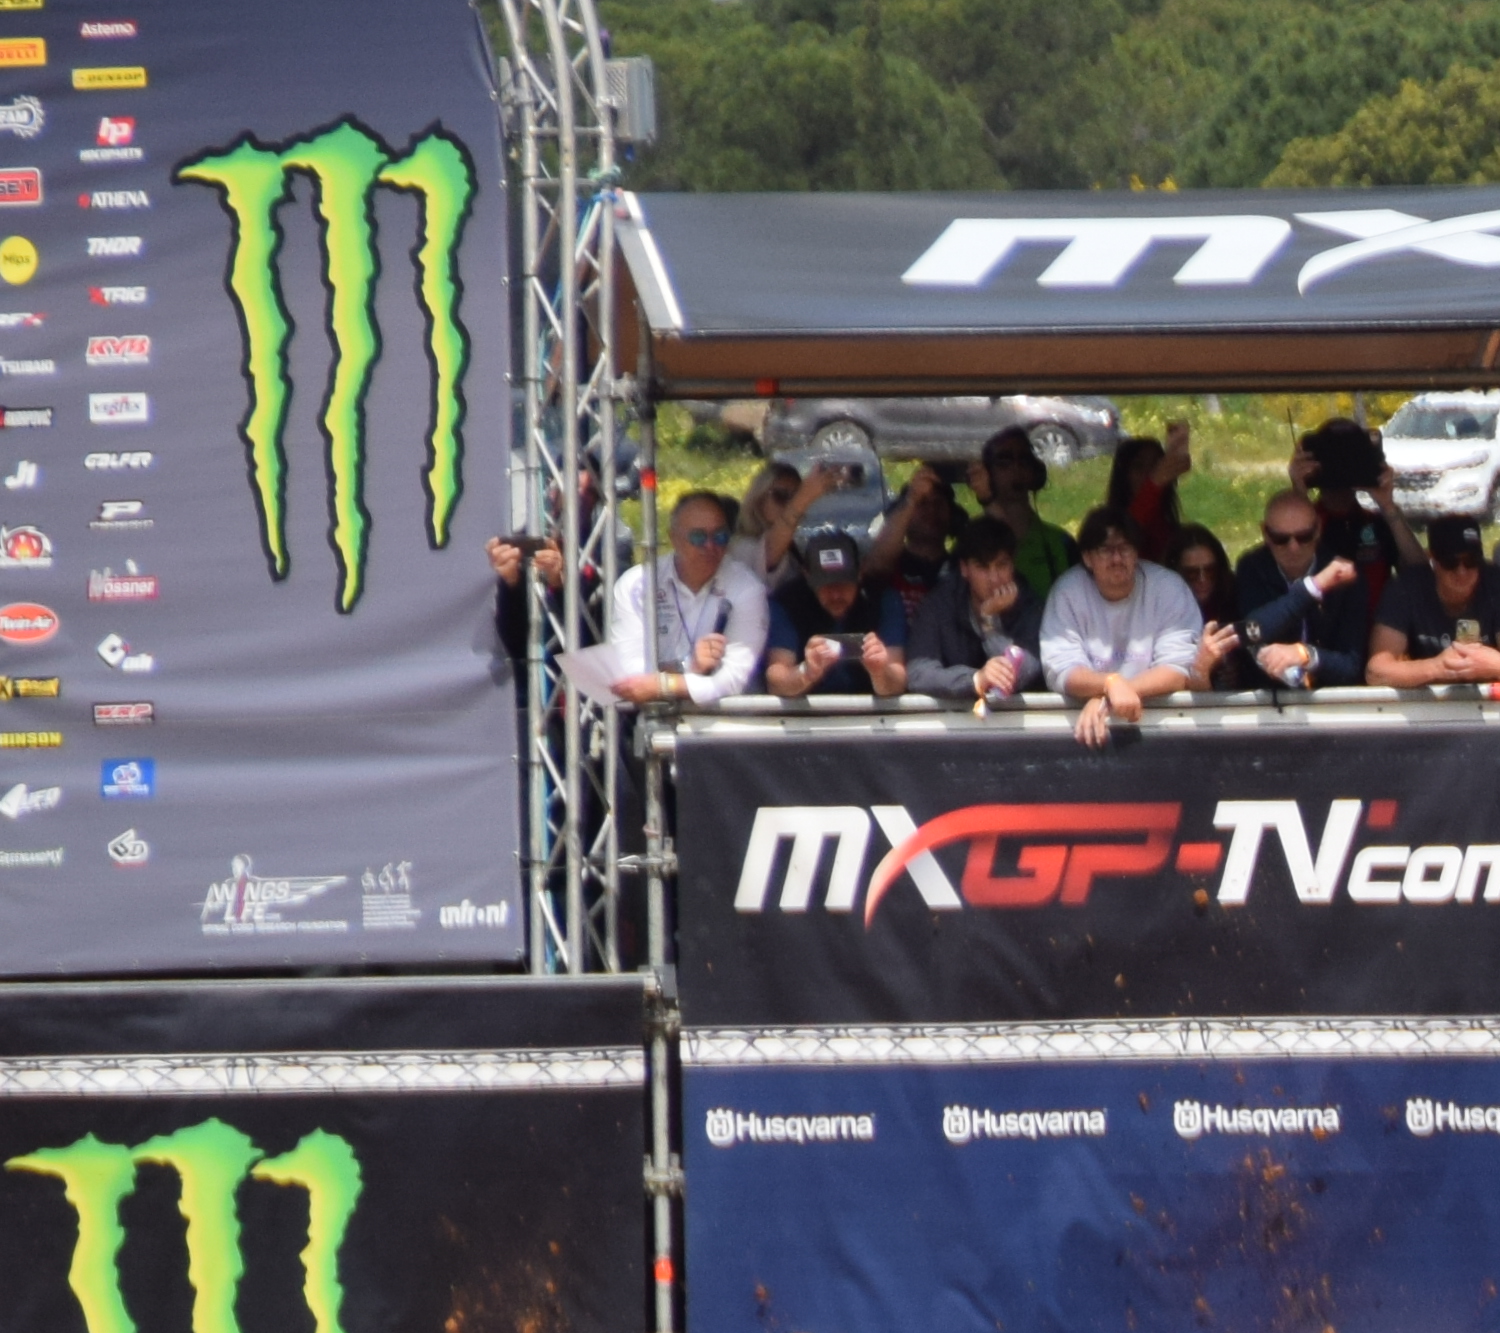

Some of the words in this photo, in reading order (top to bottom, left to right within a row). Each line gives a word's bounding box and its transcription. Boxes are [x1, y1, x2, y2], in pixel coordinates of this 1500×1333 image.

[91, 190, 149, 208] ATHENA
[735, 1110, 875, 1143] Husqvarna
[970, 1107, 1107, 1140] Husqvarna
[1203, 1104, 1340, 1136] Husqvarna
